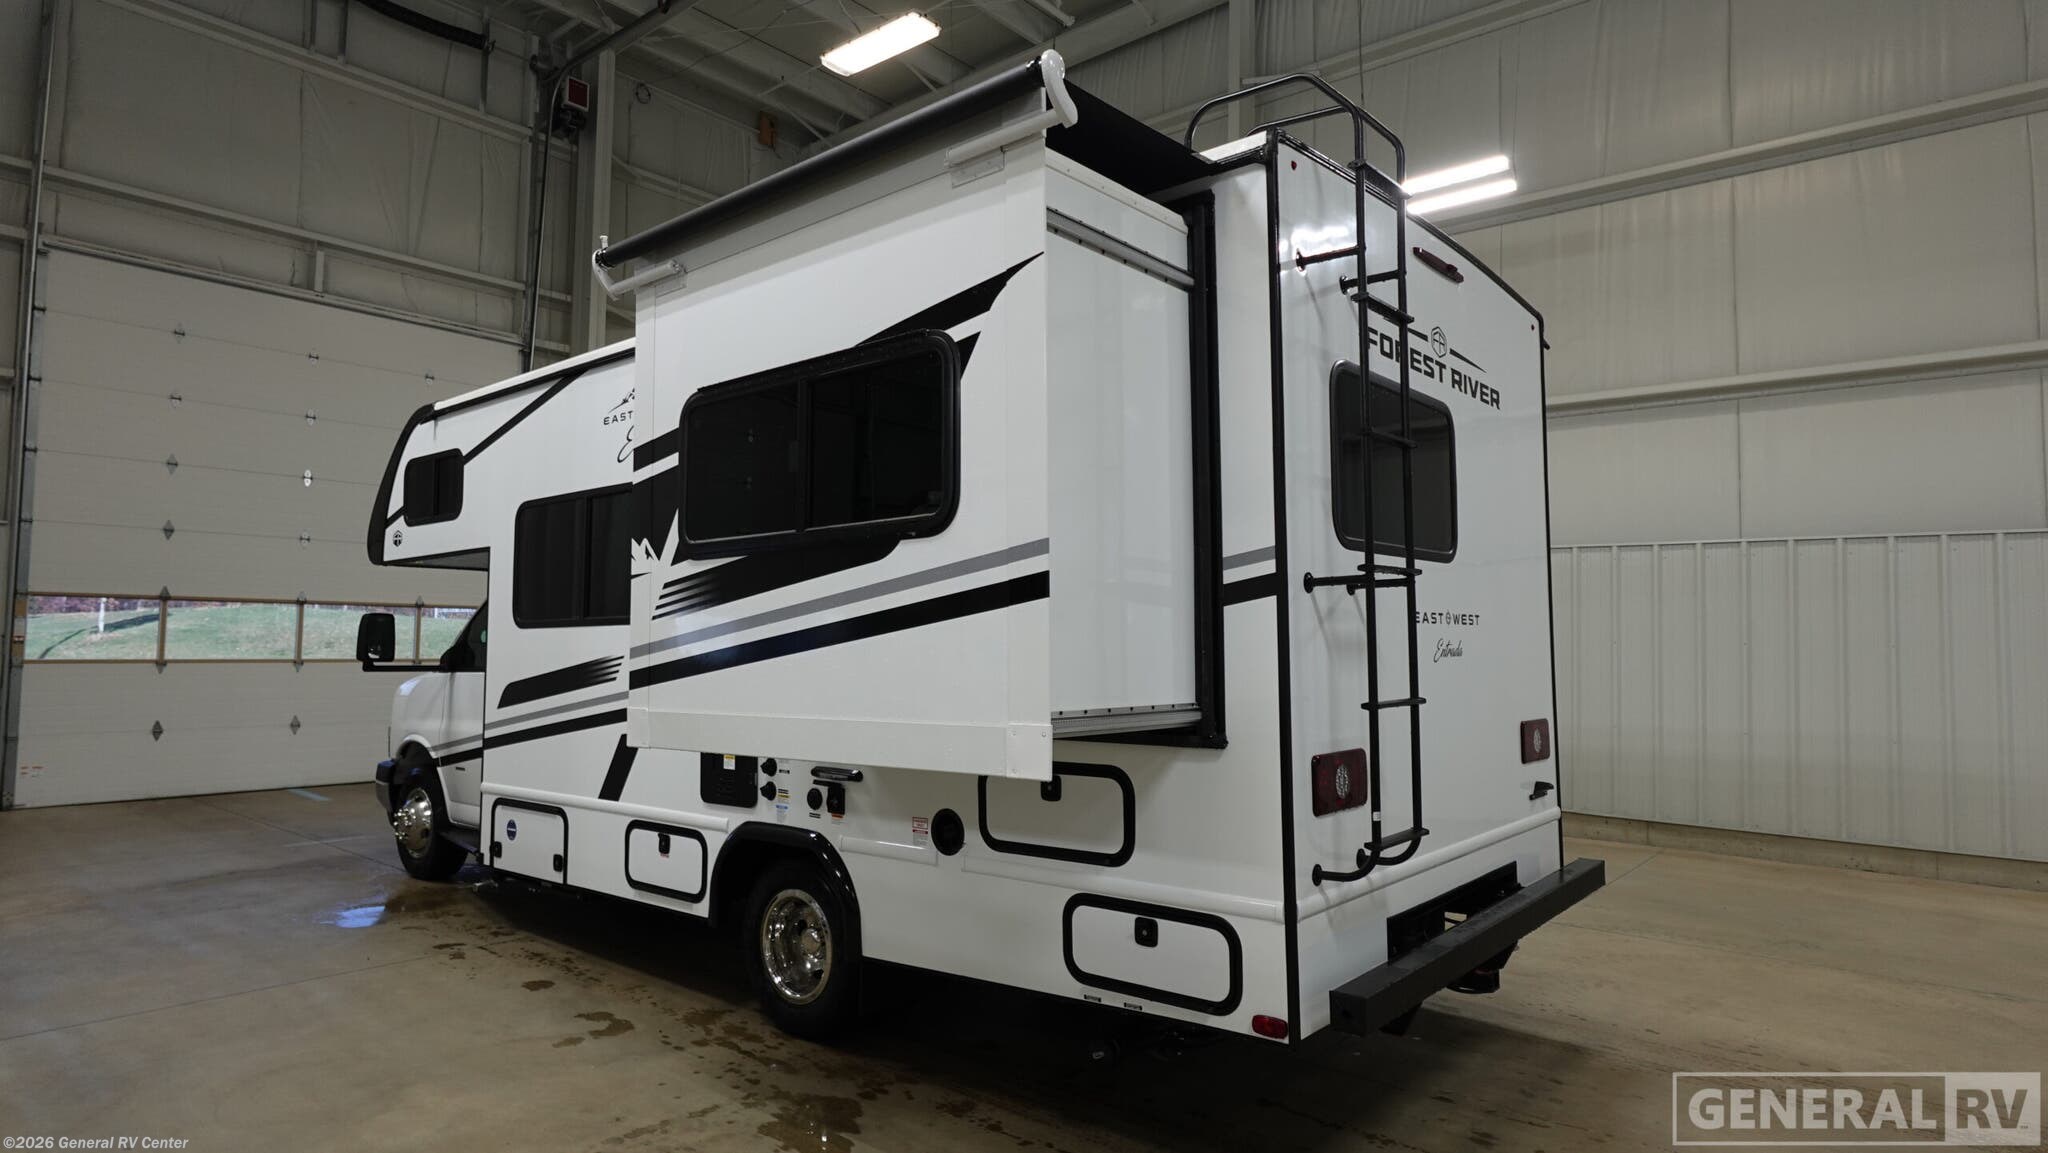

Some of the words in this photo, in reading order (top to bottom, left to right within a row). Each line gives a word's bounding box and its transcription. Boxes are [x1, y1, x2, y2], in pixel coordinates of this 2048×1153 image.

[1451, 368, 1501, 410] RIVER
[603, 411, 633, 425] EAST
[1415, 611, 1444, 624] EAST
[1452, 613, 1480, 625] WEST
[1433, 638, 1463, 663] Entrada
